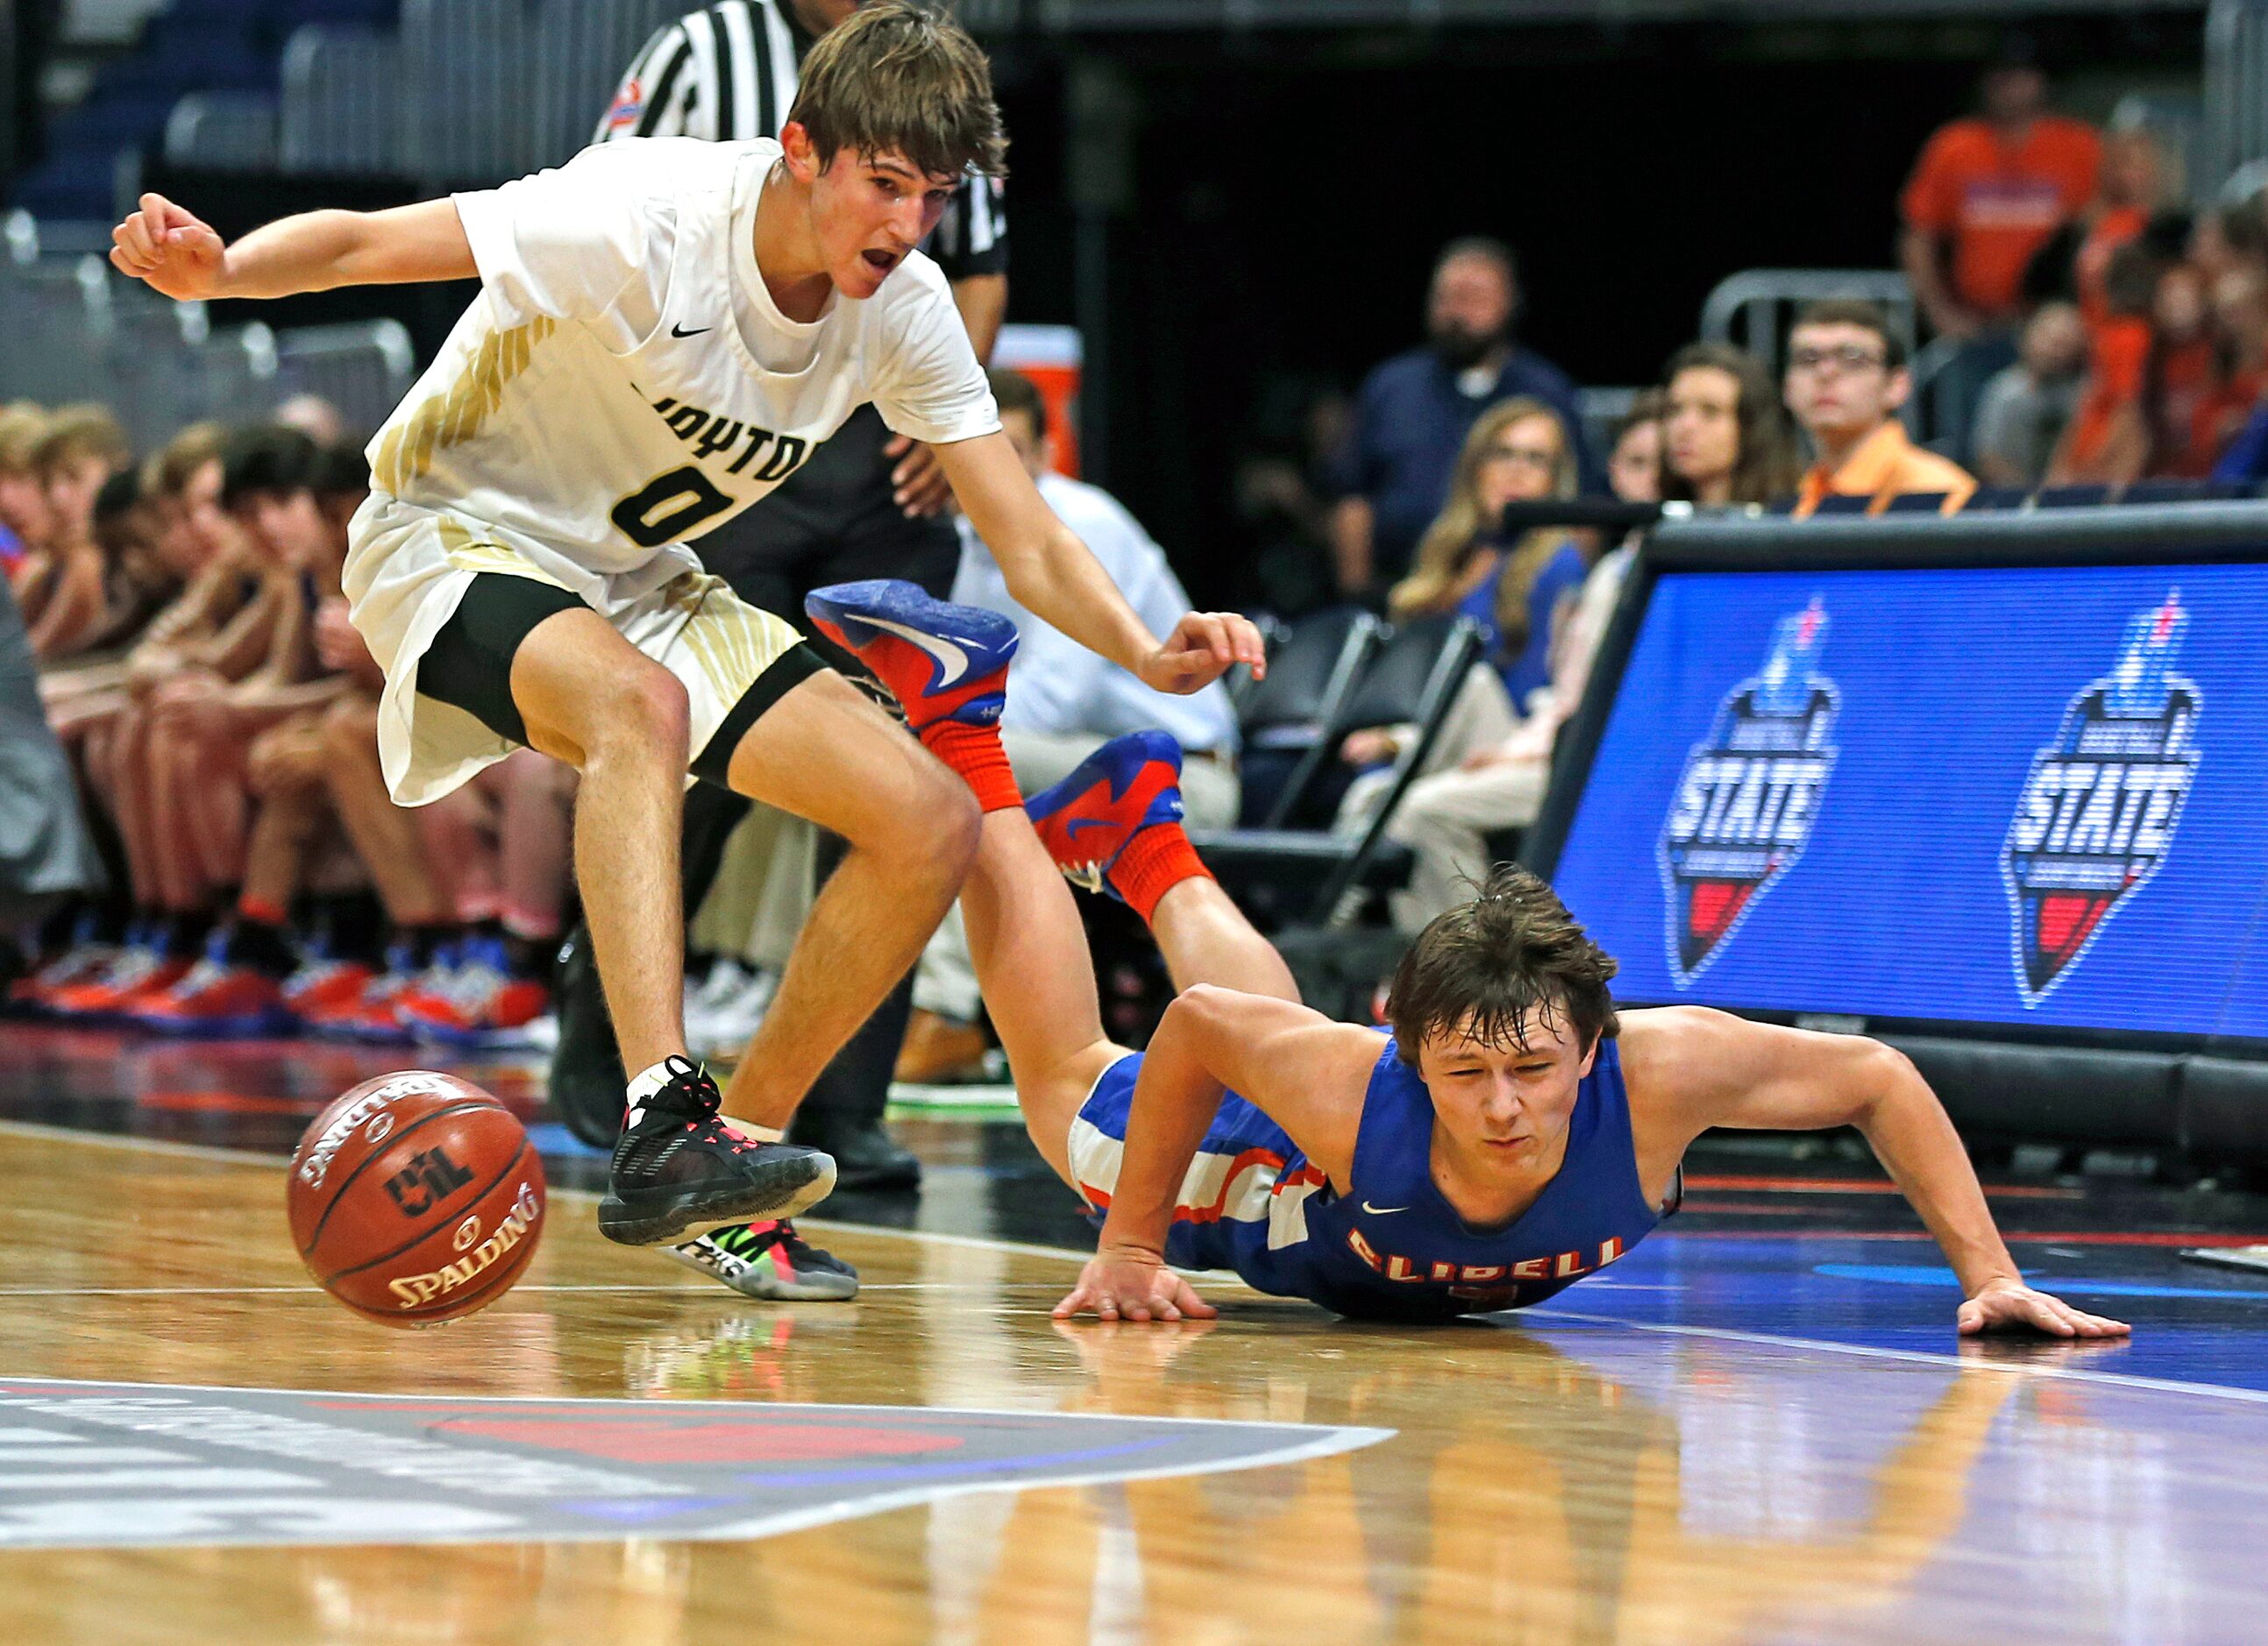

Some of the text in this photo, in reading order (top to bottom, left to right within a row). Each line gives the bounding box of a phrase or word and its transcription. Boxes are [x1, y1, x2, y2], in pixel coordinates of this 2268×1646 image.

[607, 461, 737, 549] 0
[1669, 756, 1828, 846] STATE
[2014, 762, 2189, 856] STATE
[388, 1181, 540, 1309] SPALDING
